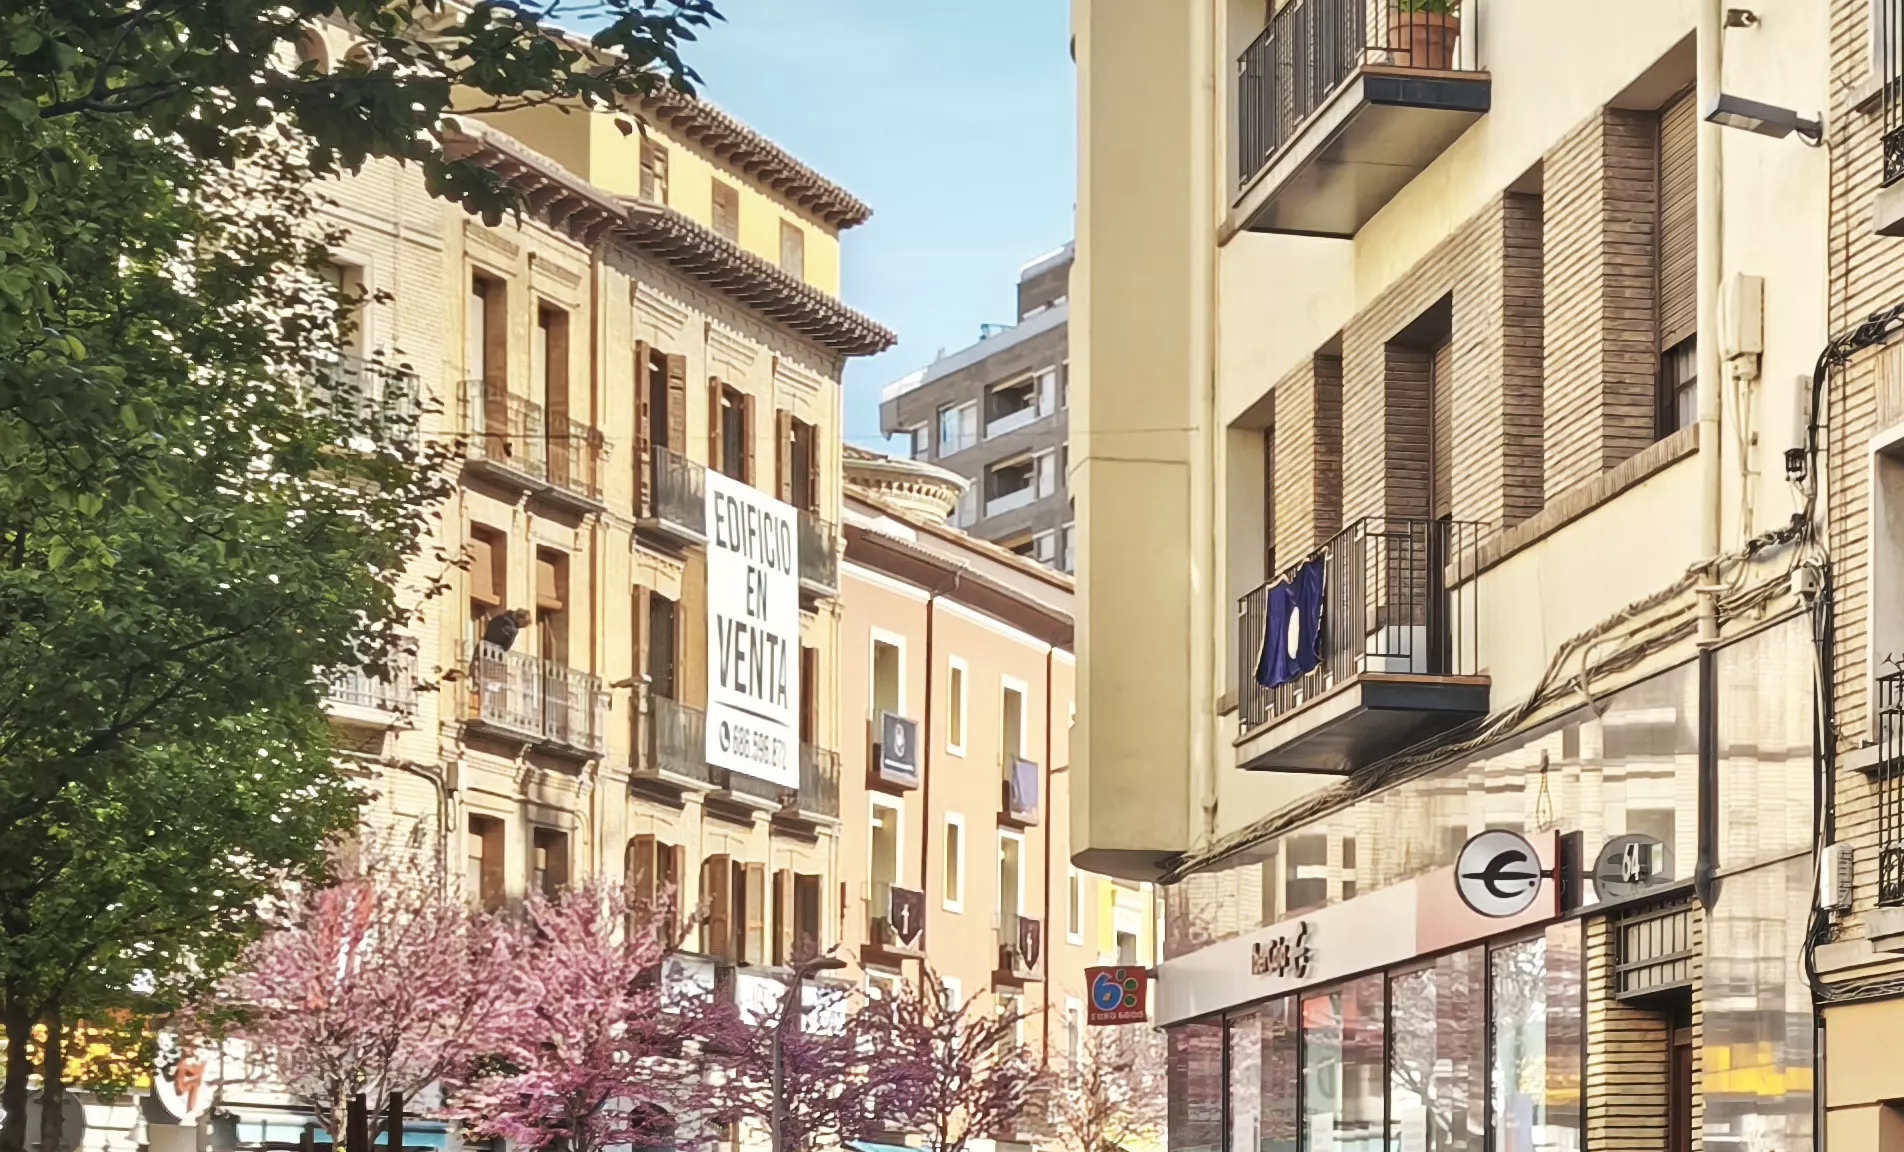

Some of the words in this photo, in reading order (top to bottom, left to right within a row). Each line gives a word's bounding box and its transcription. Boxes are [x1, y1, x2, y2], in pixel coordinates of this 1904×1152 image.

[714, 490, 791, 576] EDIFICIO
[747, 565, 767, 622] EN
[716, 613, 788, 710] VENTA
